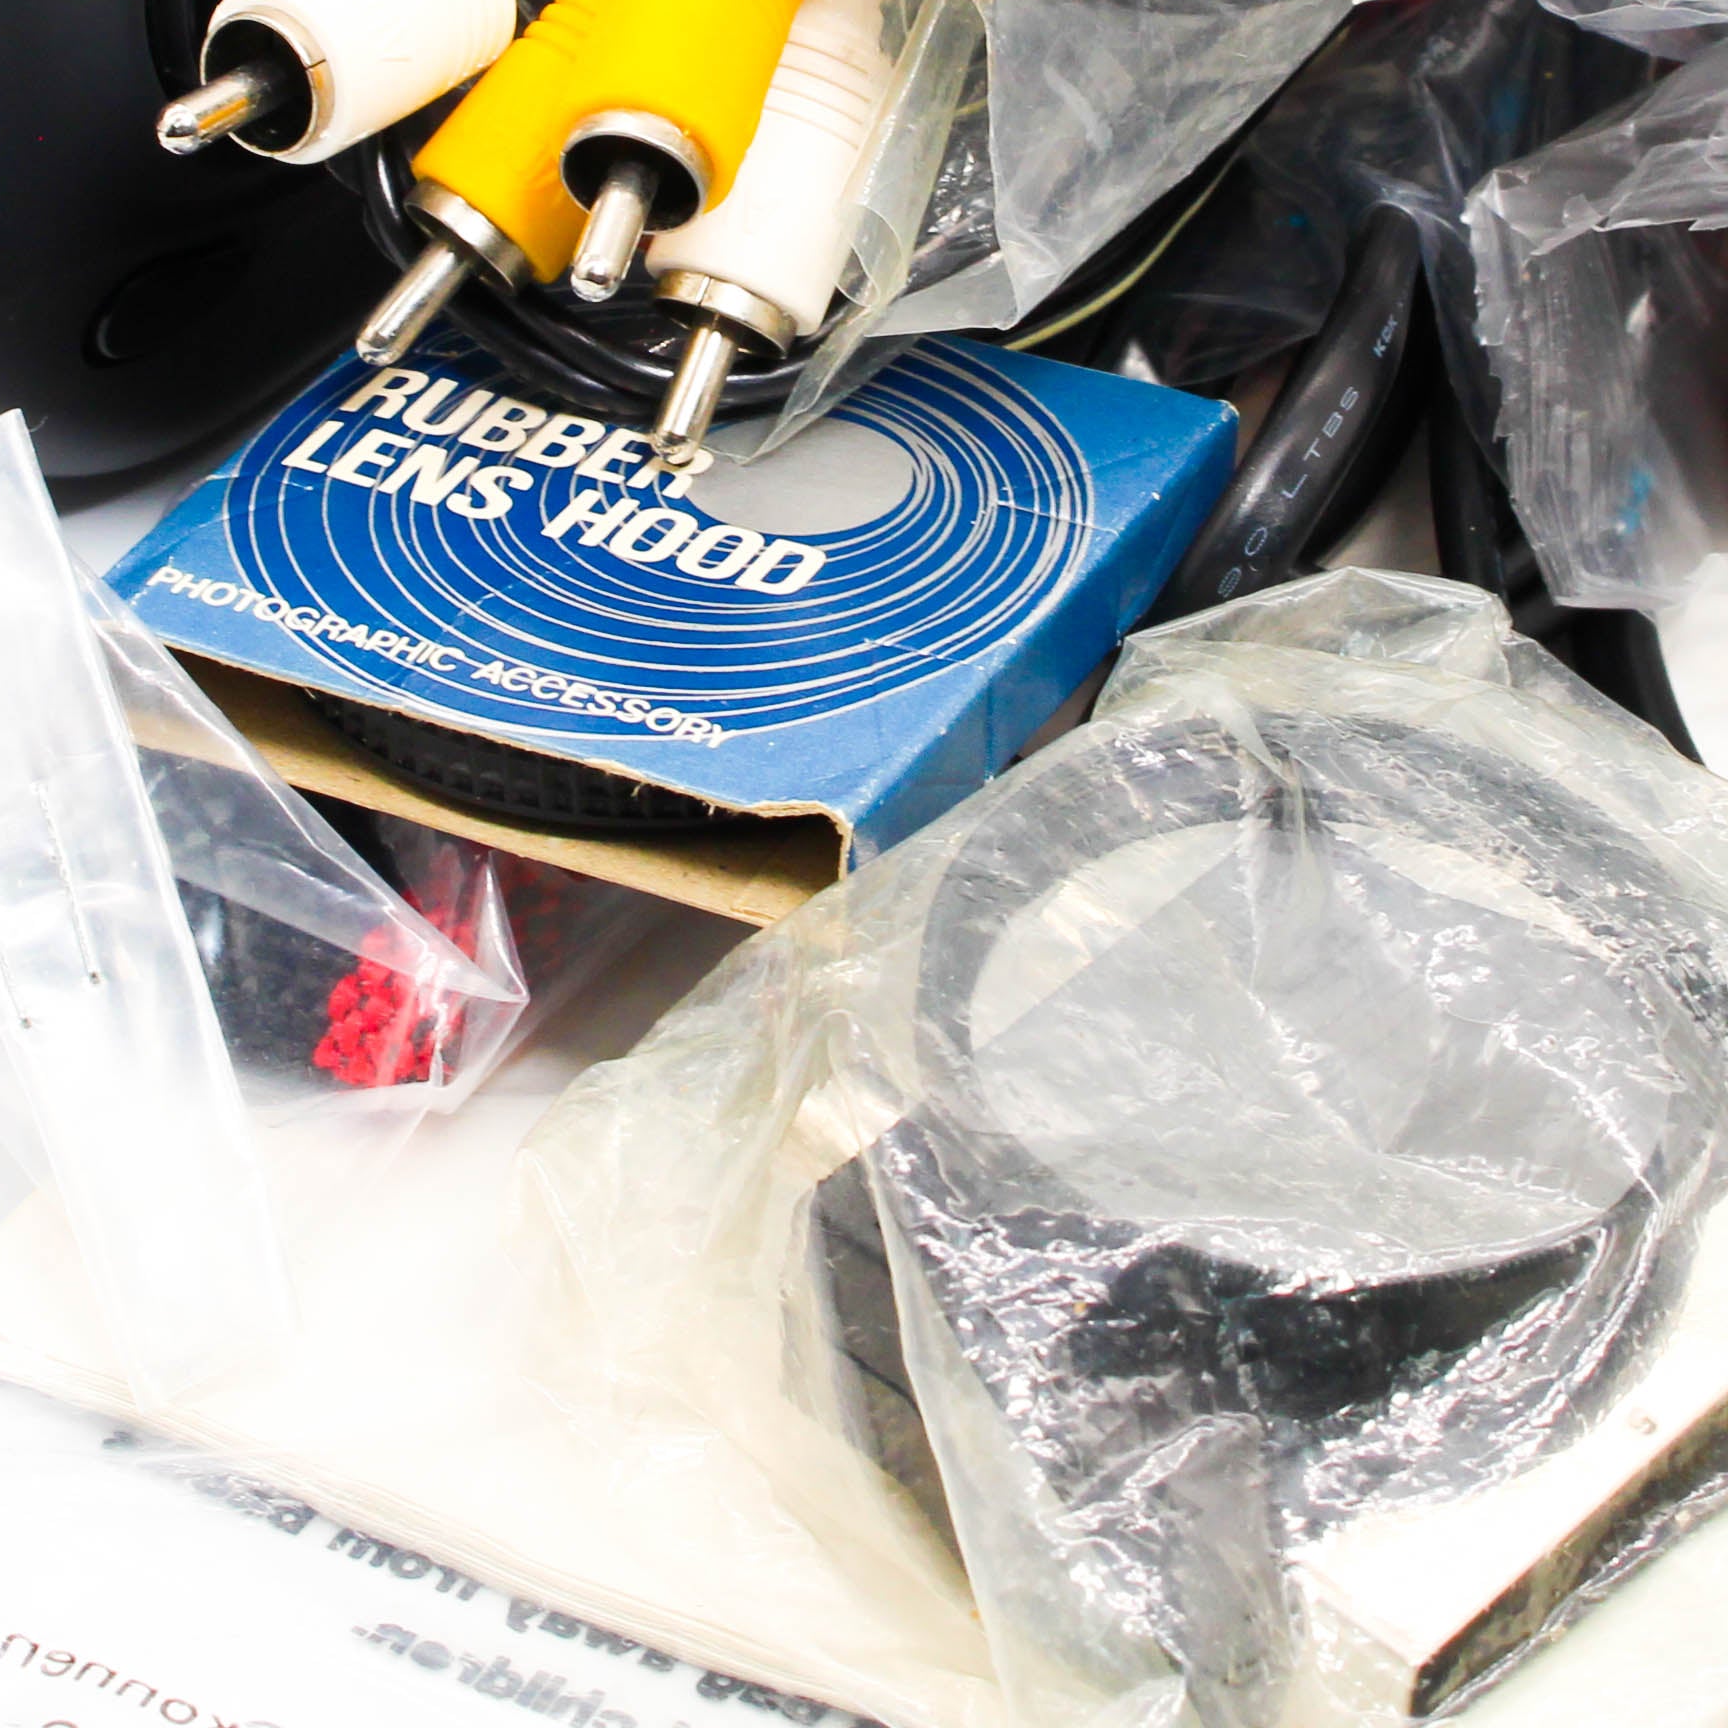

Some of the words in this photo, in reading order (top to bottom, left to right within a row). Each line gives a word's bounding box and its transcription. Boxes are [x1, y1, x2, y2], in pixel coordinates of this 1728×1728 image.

[281, 419, 535, 521] LENS
[540, 488, 828, 596] HOOD
[338, 366, 714, 500] RUBBER
[147, 566, 459, 672] PHOTOGRAPHIC
[471, 660, 740, 749] ACCESSORY
